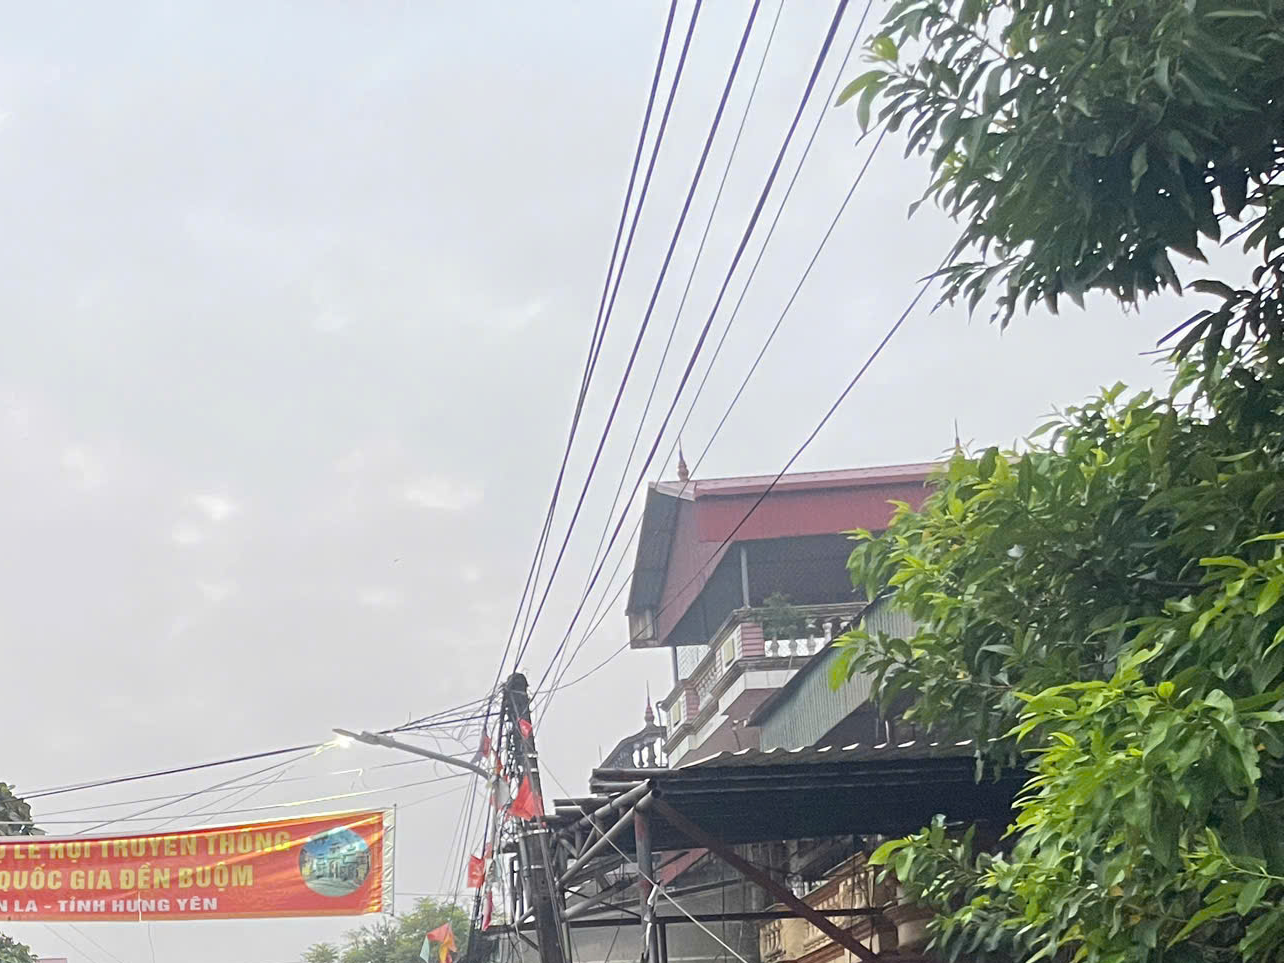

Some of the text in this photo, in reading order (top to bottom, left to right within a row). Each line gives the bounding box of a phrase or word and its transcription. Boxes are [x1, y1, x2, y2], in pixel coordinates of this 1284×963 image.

[70, 869, 112, 890] GIA
[14, 900, 38, 912] LA
[176, 896, 218, 911] YÊN
